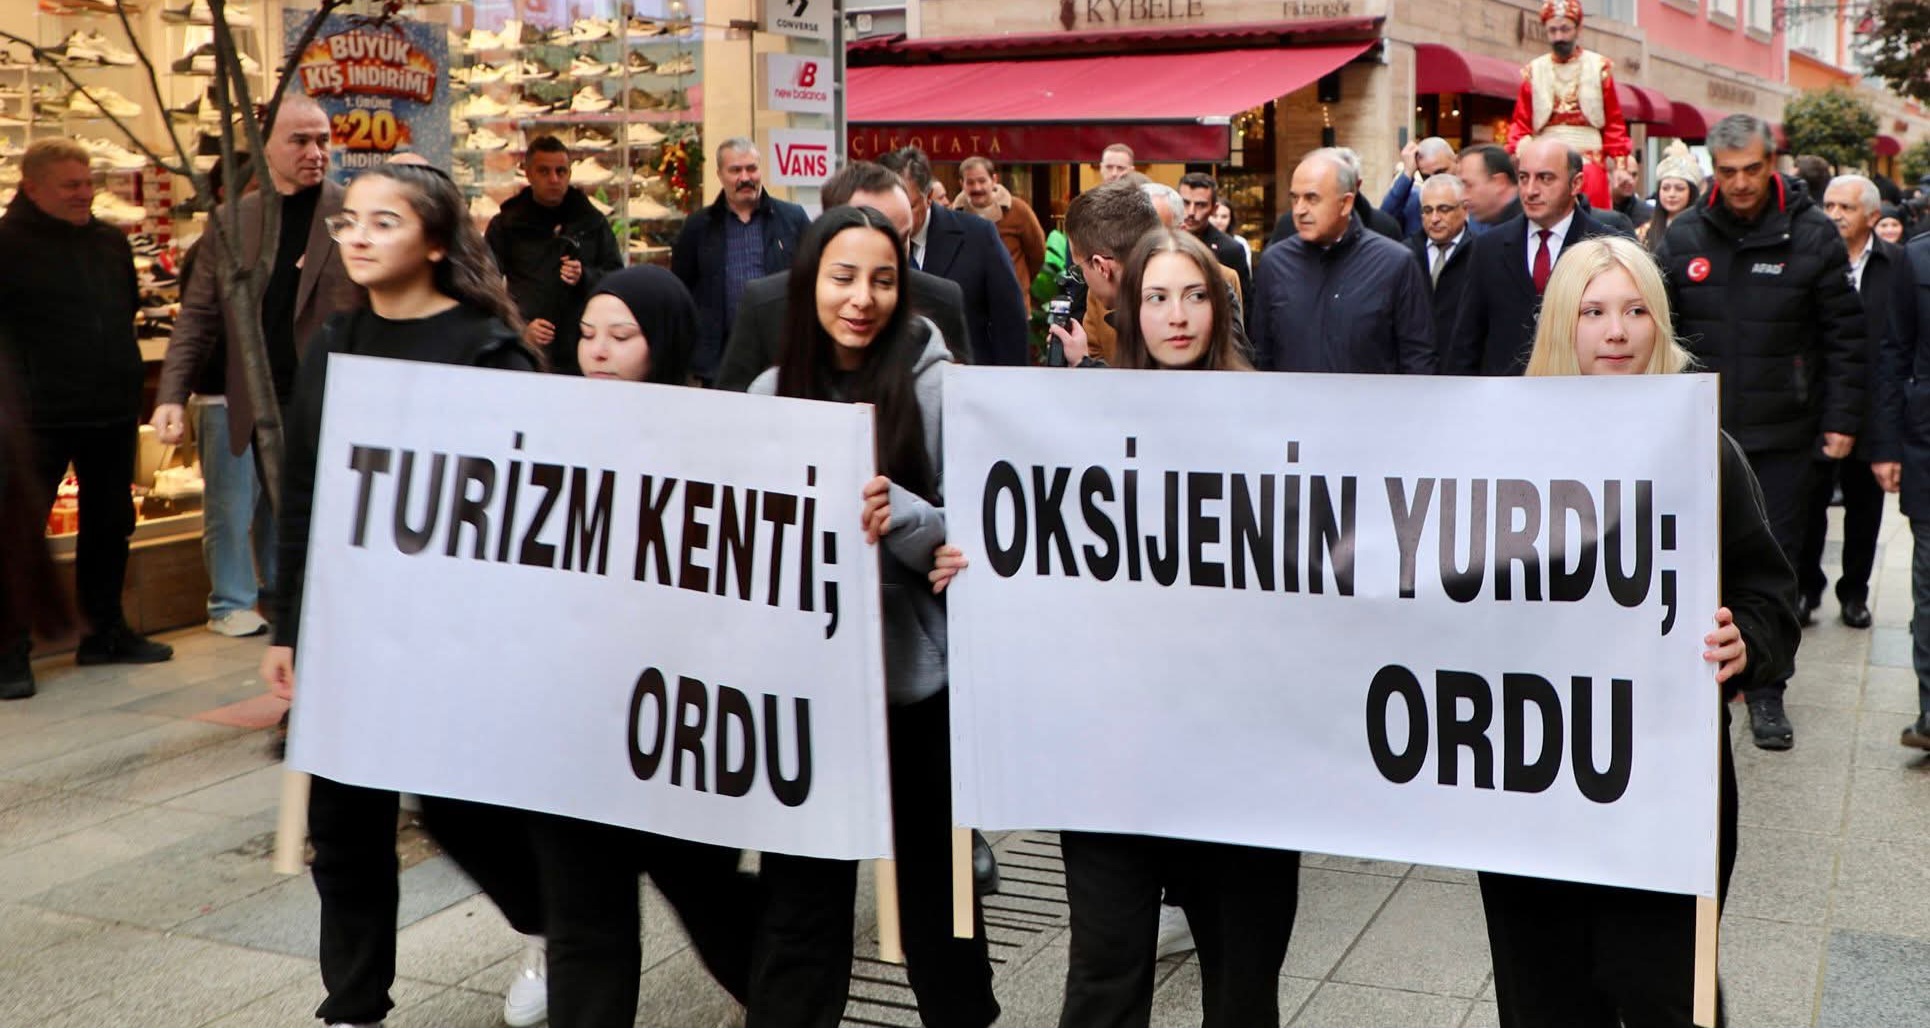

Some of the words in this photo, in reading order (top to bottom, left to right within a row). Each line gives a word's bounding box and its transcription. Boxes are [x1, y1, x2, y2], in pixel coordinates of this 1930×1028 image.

[776, 18, 819, 32] CONVERSE
[1087, 0, 1204, 22] KYBELE
[329, 30, 411, 65] BÜYÜK
[305, 65, 345, 93] KIŞ
[349, 62, 430, 95] İNDİRİMİ
[774, 88, 791, 98] new
[793, 88, 827, 101] balance
[334, 108, 397, 151] %20
[774, 143, 828, 177] VANS
[349, 432, 615, 575] TURİZM
[634, 466, 839, 639] KENTİ;
[983, 437, 1356, 597] OKSİJENİN
[1385, 476, 1678, 636] YURDU;
[627, 667, 812, 807] ORDU
[1366, 664, 1632, 803] ORDU
